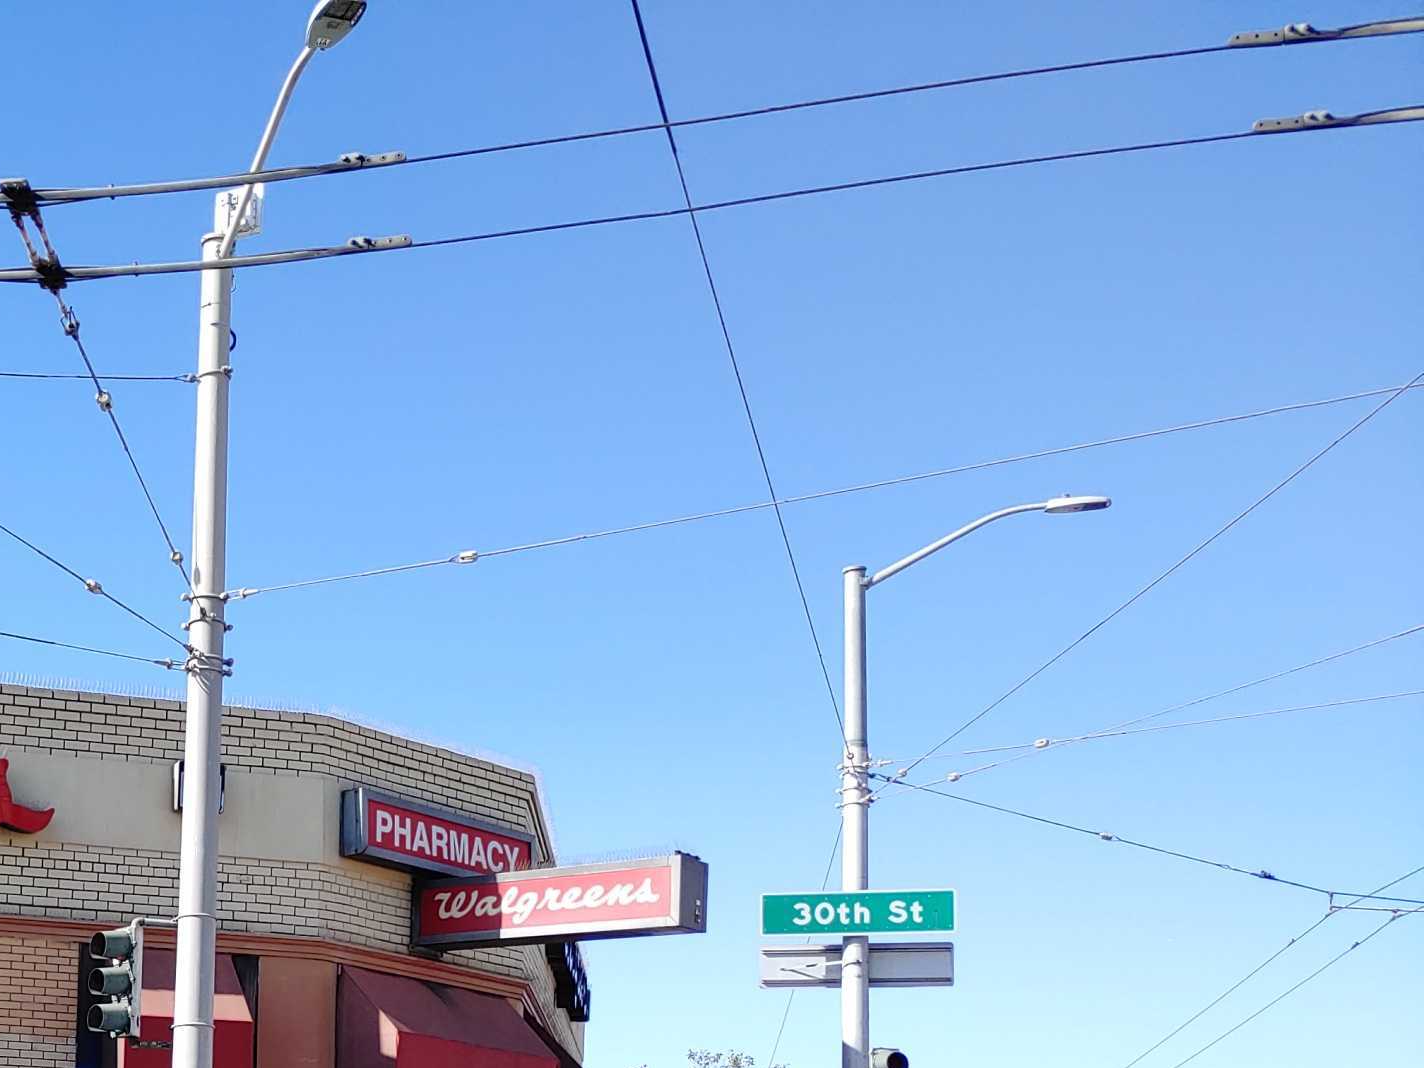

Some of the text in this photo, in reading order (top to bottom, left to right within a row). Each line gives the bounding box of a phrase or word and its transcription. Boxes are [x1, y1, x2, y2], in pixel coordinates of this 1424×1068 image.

[376, 809, 520, 872] PHARMACY
[433, 876, 661, 925] Walgreens
[791, 900, 924, 926] 30th St
